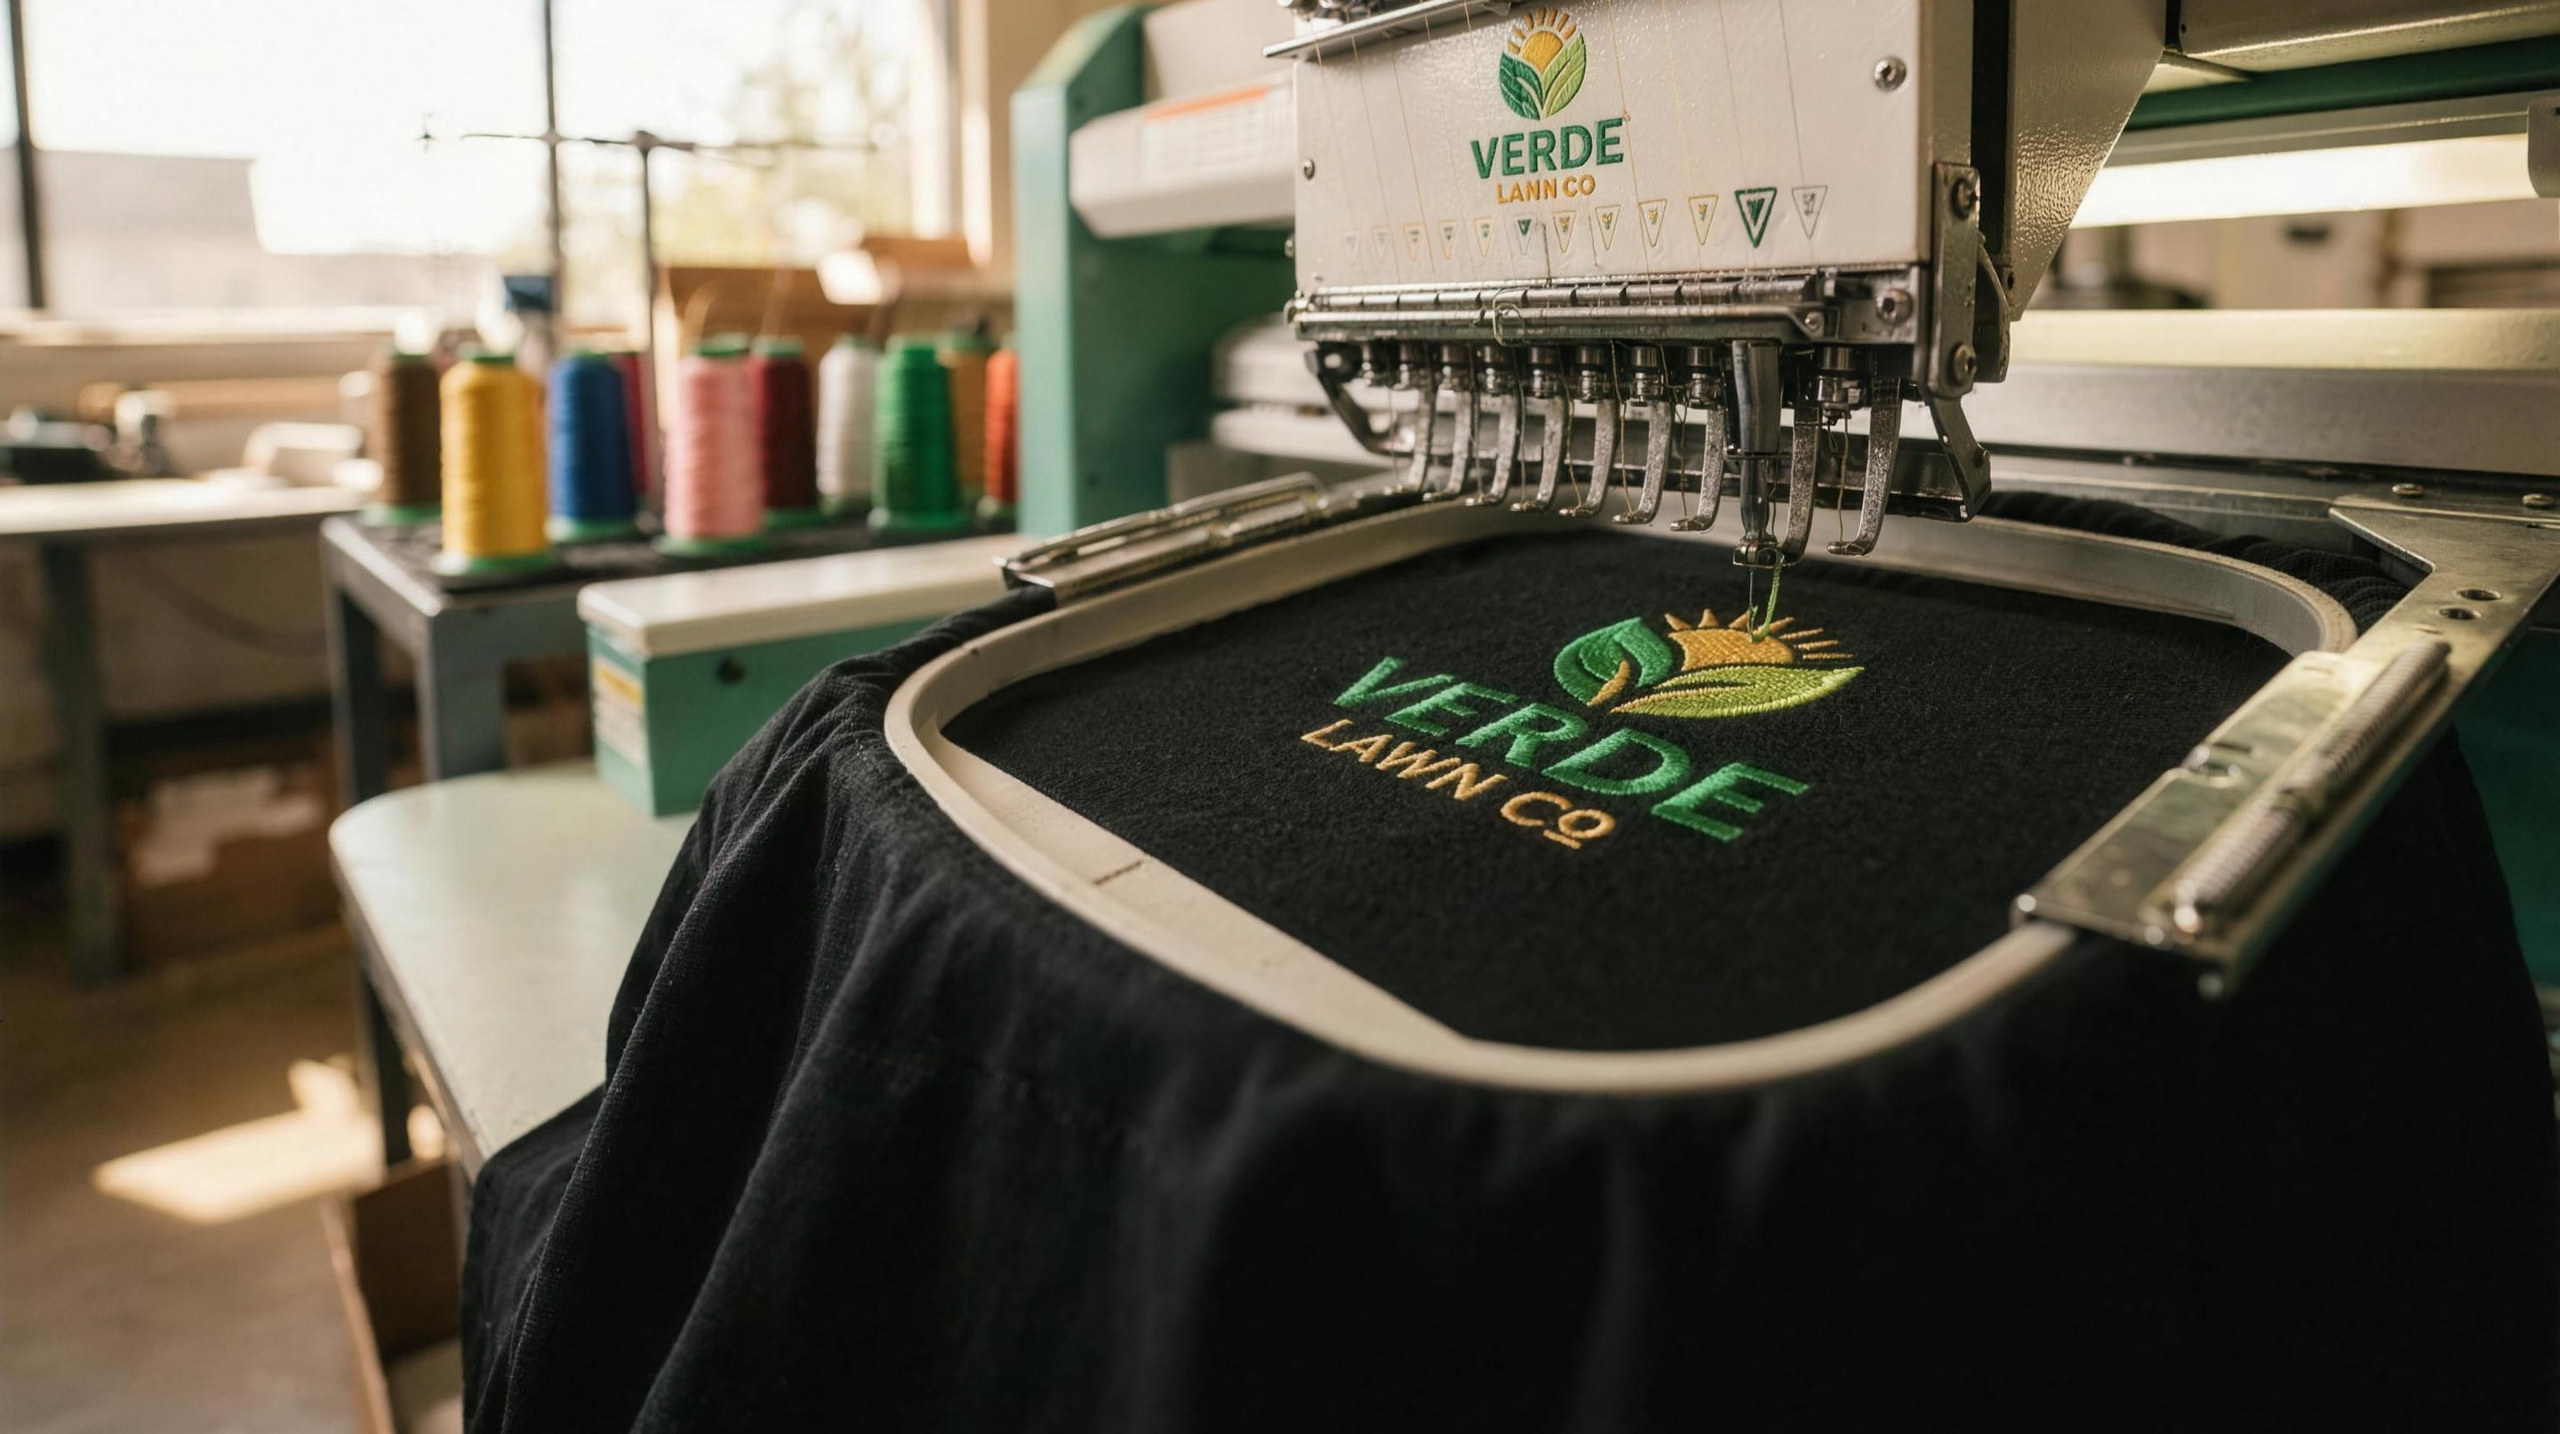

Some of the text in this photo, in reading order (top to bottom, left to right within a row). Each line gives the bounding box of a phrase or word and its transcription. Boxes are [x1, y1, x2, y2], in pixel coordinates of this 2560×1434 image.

[1470, 117, 1624, 179] VERDE
[1496, 174, 1596, 205] LANN CO
[1300, 719, 1508, 801] LAWN
[1333, 656, 1810, 842] VERDE
